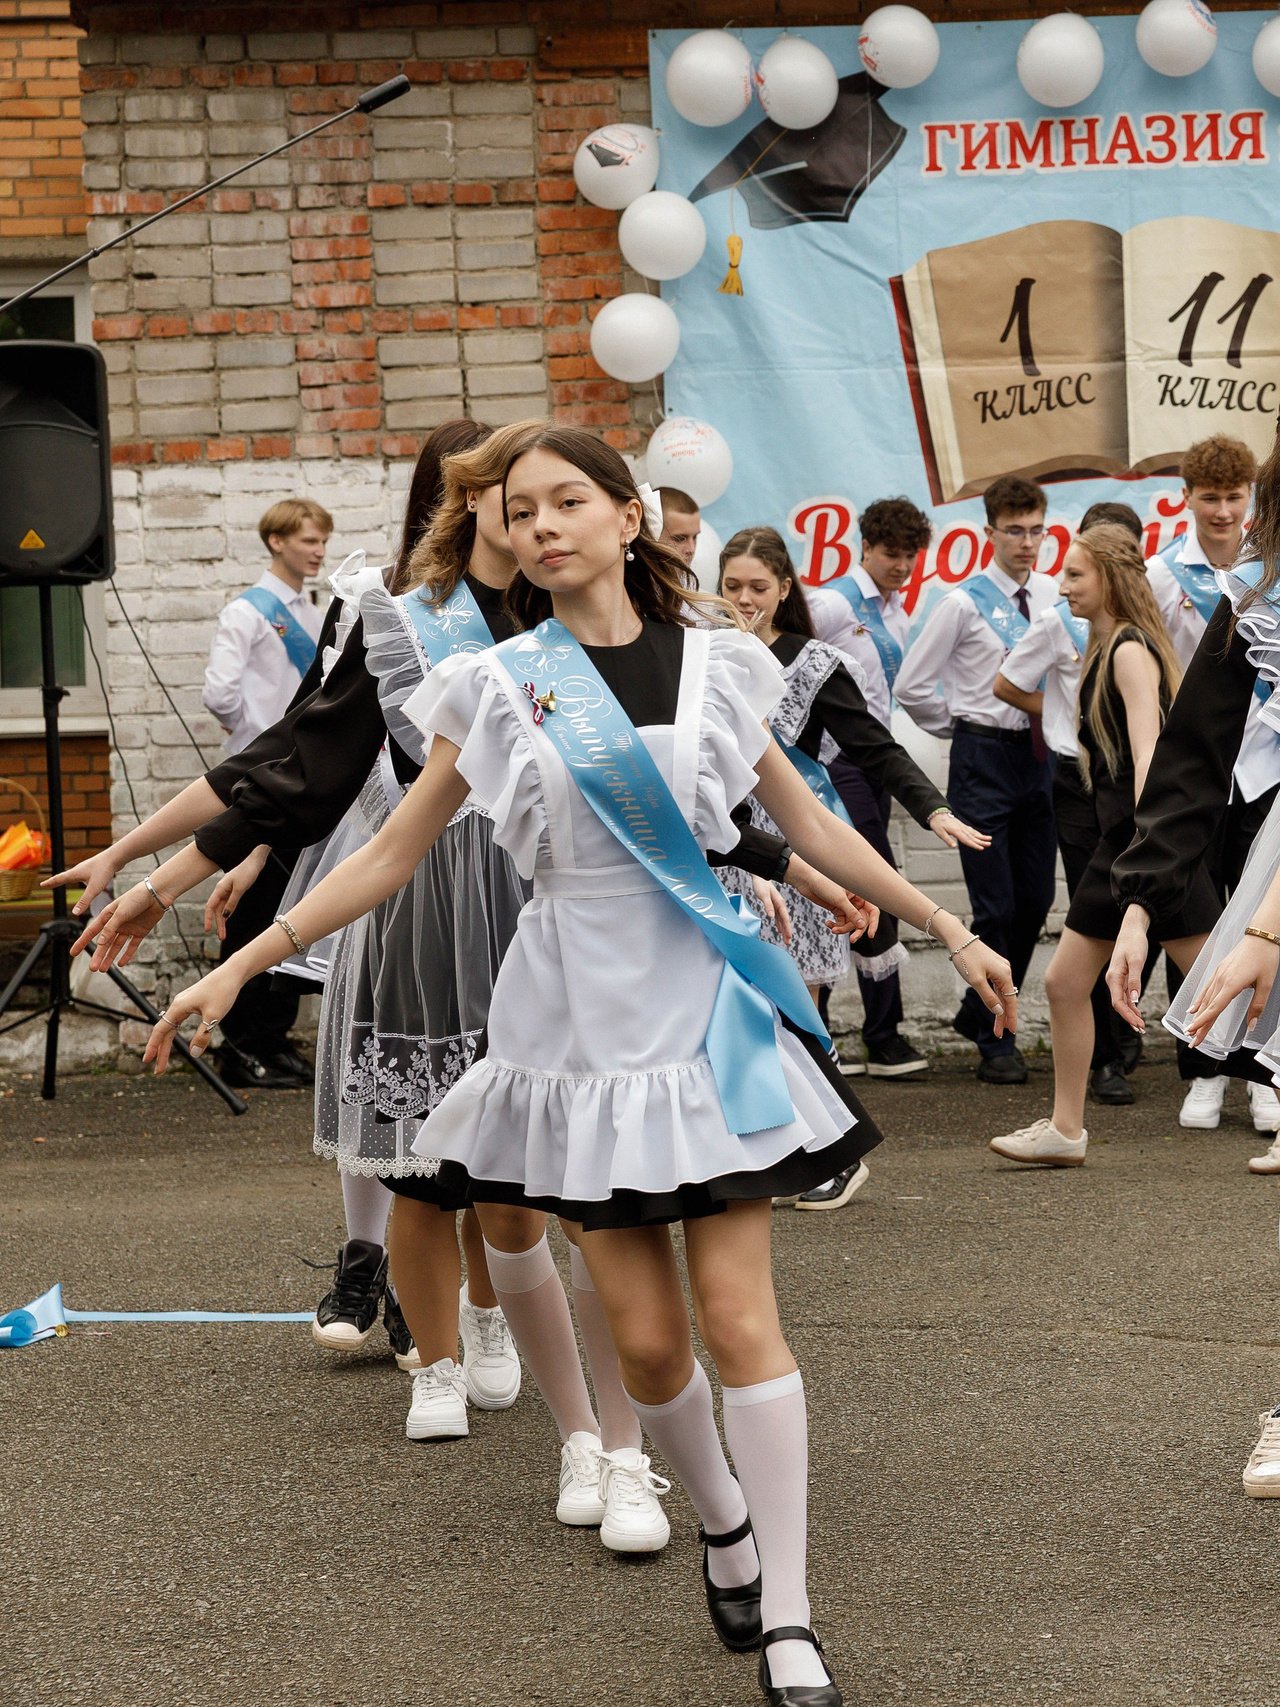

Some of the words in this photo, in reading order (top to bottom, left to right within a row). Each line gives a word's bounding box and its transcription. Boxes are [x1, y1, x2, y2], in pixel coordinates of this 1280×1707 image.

[923, 111, 1266, 173] ГИМНАЗИЯ
[999, 277, 1042, 377] 1
[1167, 271, 1274, 370] 11
[973, 371, 1096, 424] КЛАСС
[1157, 373, 1277, 413] КЛАСС
[794, 502, 853, 587] В
[547, 674, 668, 866] Выпускница
